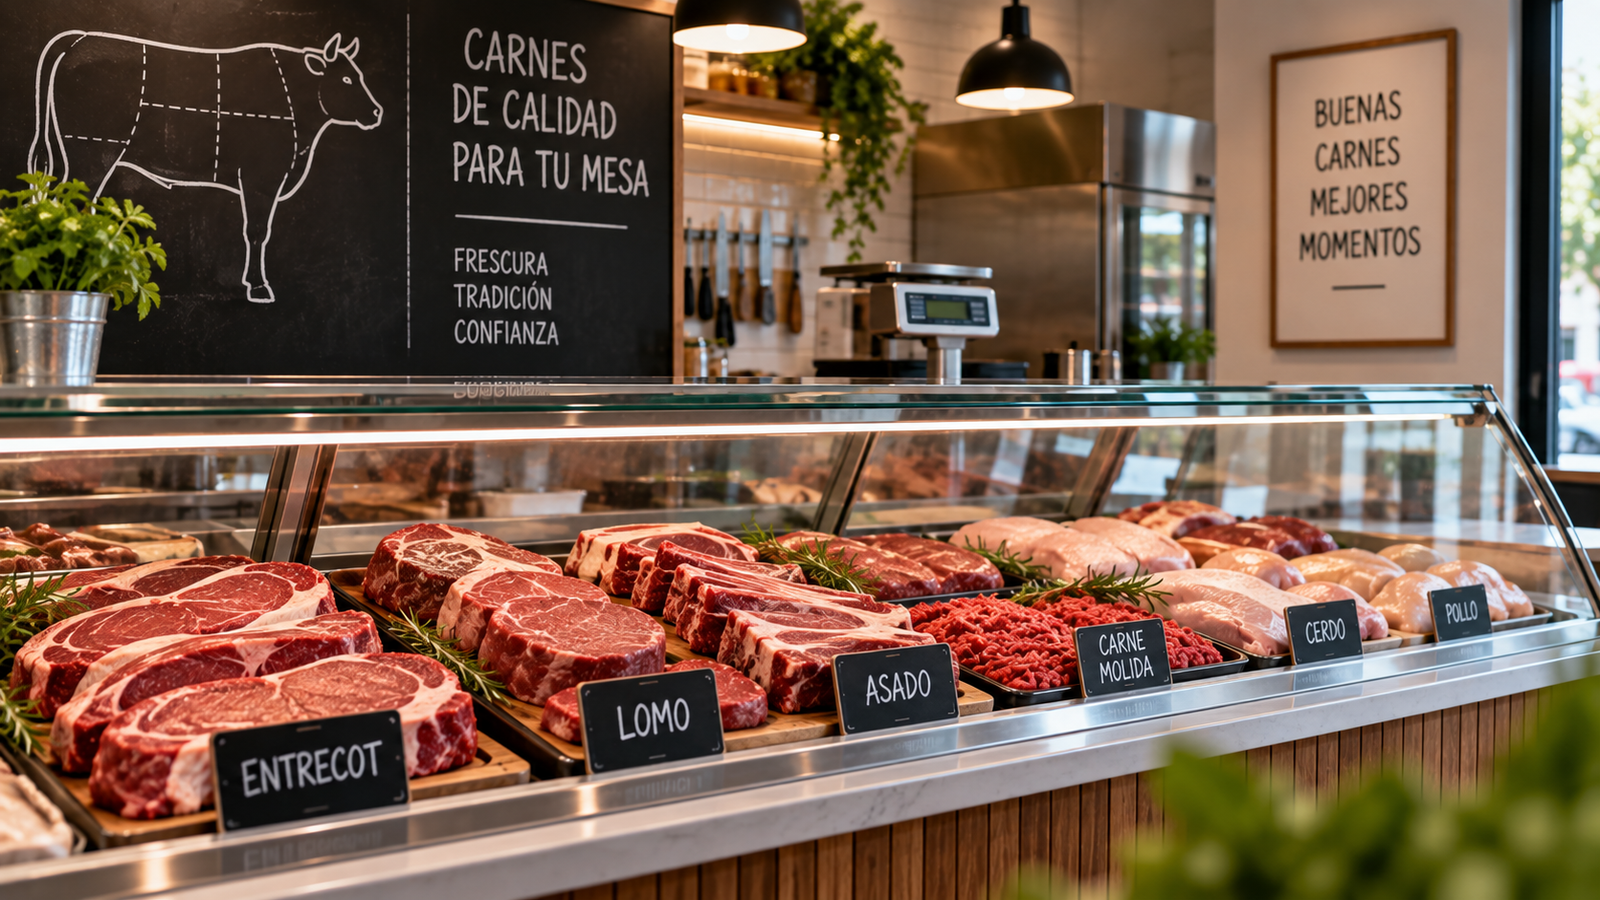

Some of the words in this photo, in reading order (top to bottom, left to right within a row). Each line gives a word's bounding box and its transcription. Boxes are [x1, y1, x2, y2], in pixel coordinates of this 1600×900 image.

[464, 27, 587, 84] CARNES
[453, 83, 489, 126] DE
[502, 90, 617, 140] CALIDAD
[1315, 90, 1402, 128] BUENAS
[453, 142, 524, 187] PARA
[536, 150, 569, 190] TU
[582, 155, 650, 197] MESA
[1315, 136, 1400, 172] CARNES
[1310, 181, 1408, 216] MEJORES
[1299, 226, 1421, 261] MOMENTOS
[454, 248, 548, 276] FRESCURA
[454, 281, 552, 311] TRADICIÓN
[454, 319, 559, 346] CONFIANZA
[1445, 600, 1478, 625] POLLO
[1098, 629, 1146, 657] CARNE
[1305, 618, 1346, 645] CERDO
[866, 669, 931, 706] ASADO
[1099, 656, 1154, 684] MOLIDA
[617, 697, 690, 741] LOMO
[241, 740, 383, 798] ENTRECOT
